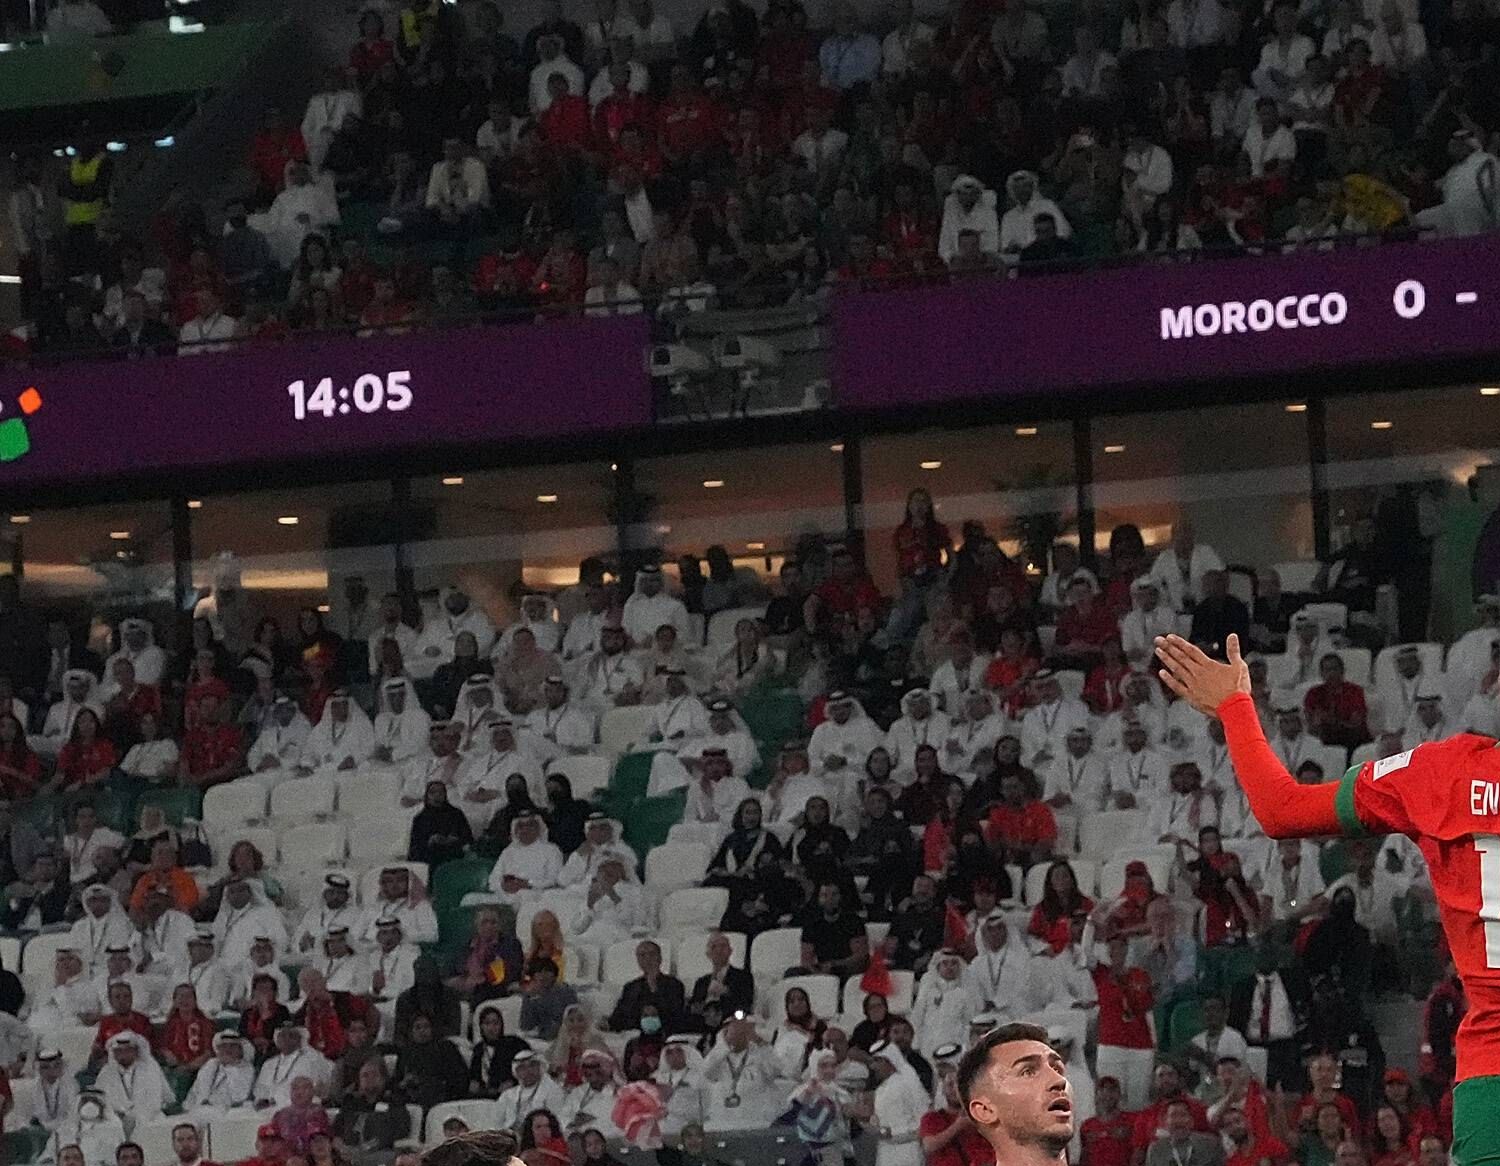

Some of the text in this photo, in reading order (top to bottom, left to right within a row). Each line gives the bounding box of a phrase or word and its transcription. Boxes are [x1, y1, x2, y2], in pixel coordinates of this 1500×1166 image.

[1160, 292, 1348, 340] MOROCCO
[1393, 280, 1425, 319] 0
[287, 370, 414, 421] 14:05
